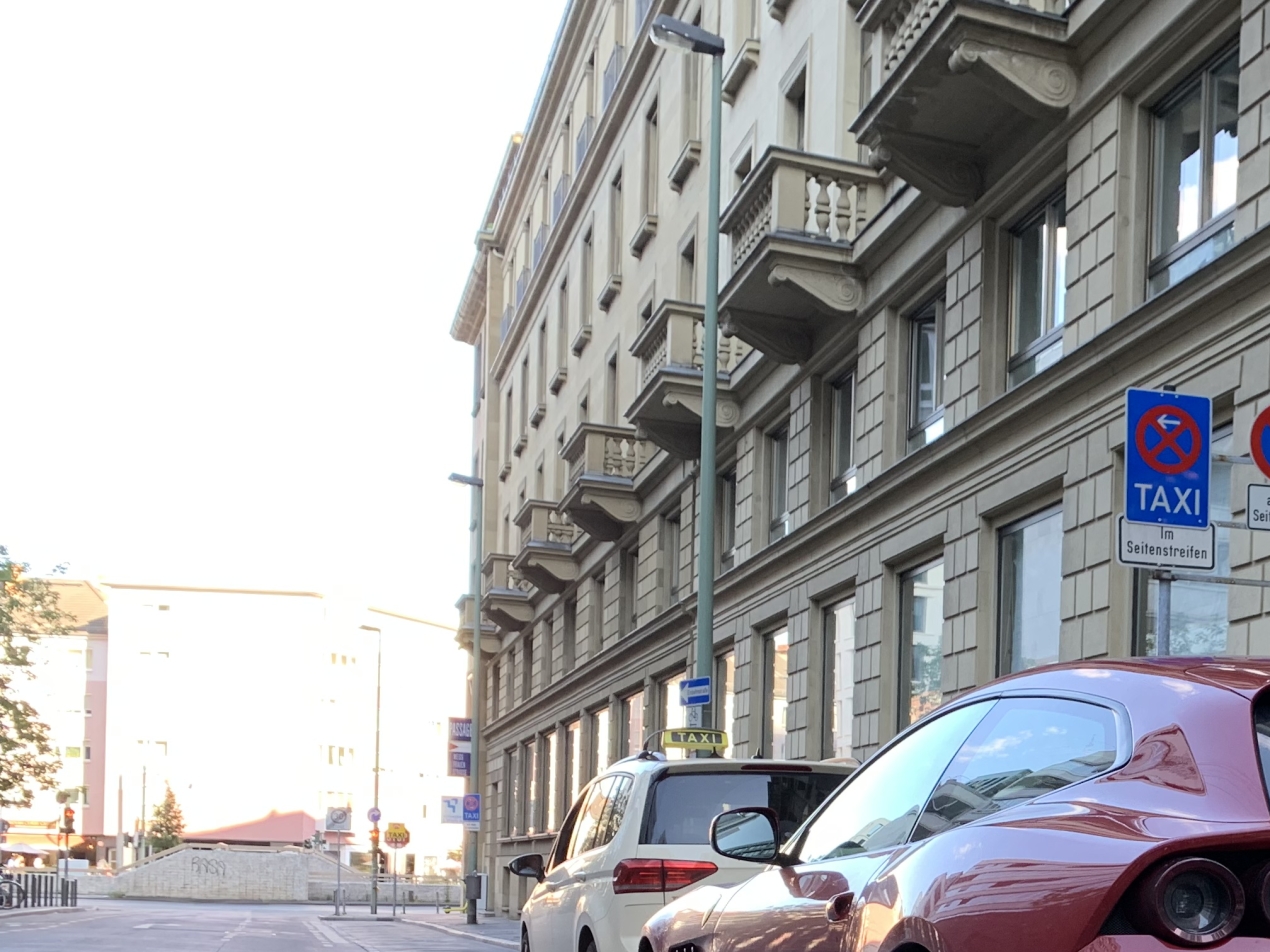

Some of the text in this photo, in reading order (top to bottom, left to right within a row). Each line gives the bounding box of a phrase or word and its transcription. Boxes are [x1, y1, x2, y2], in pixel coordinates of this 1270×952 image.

[1134, 483, 1200, 516] TAXI
[1127, 541, 1207, 559] Seitenstreifen
[677, 732, 716, 744] TAXI
